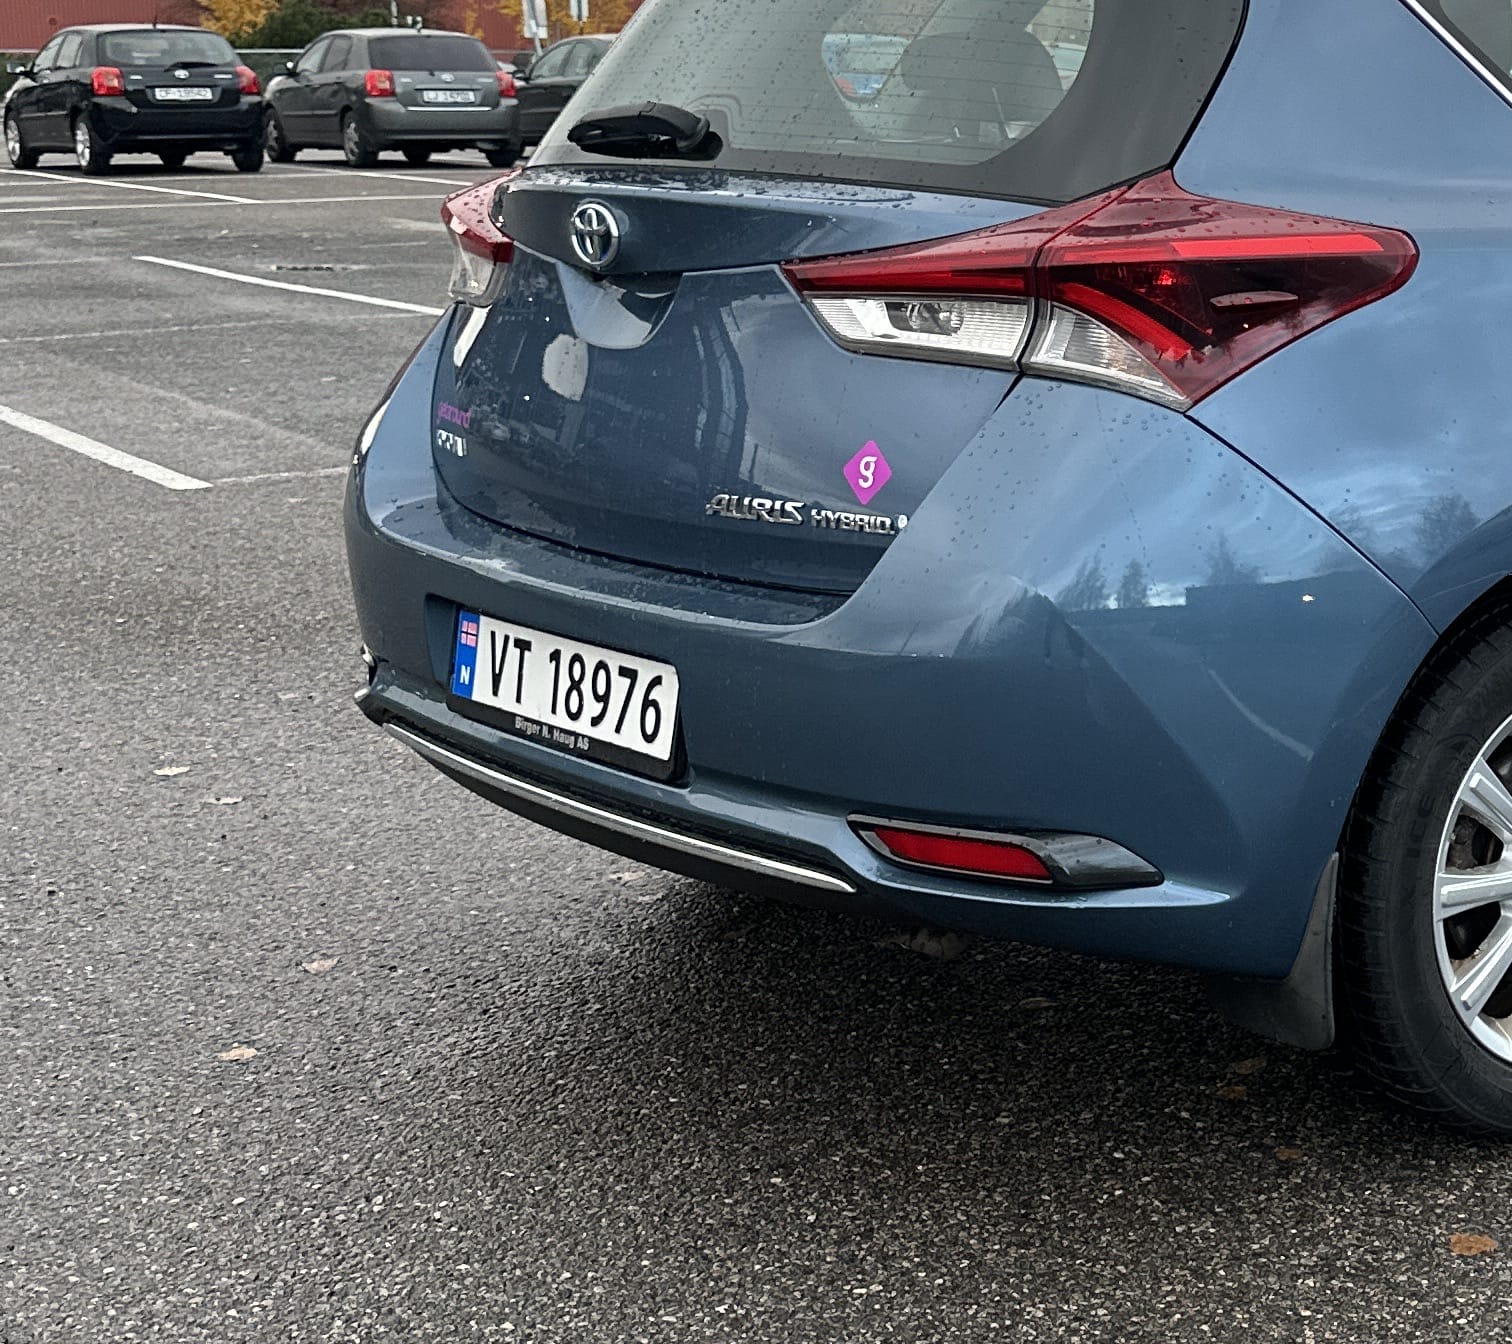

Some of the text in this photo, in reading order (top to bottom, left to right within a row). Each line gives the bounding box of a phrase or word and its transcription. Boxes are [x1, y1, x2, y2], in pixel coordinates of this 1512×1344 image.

[858, 456, 878, 489] g
[706, 493, 896, 535] AURIS HYBRID
[460, 630, 663, 744] N VT 18976
[514, 716, 590, 751] Birger N. Haug AS
